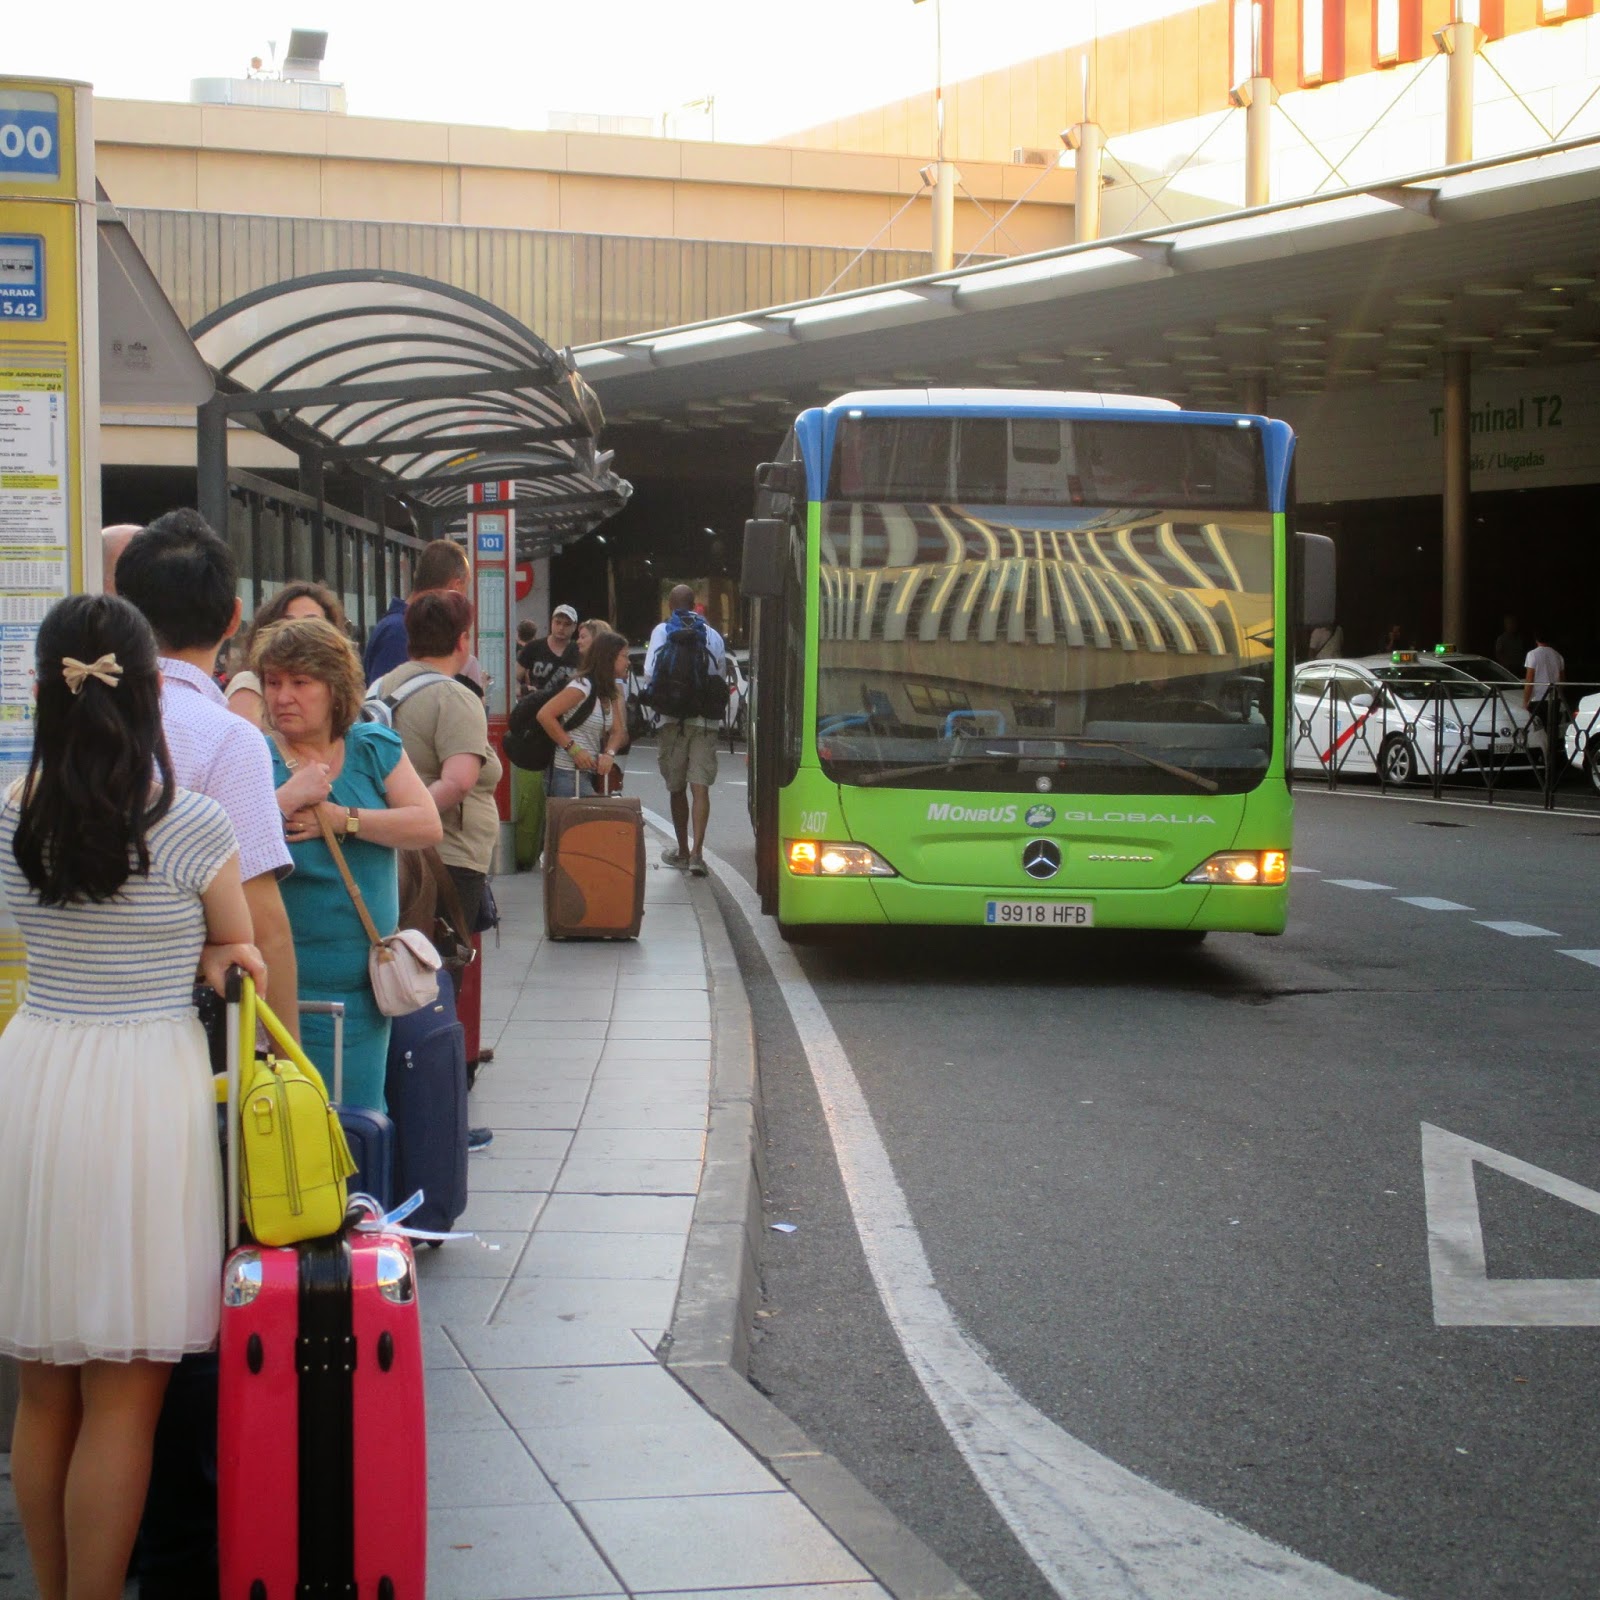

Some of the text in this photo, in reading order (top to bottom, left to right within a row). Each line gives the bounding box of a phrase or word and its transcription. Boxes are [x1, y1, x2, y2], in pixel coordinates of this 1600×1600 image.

[3, 301, 37, 316] 542
[1429, 394, 1563, 437] Tminal T2
[1497, 452, 1545, 472] Llegadas
[481, 537, 499, 549] 101
[800, 811, 828, 834] 2407
[927, 803, 1018, 823] MONBUS
[1064, 810, 1217, 825] GLOBALIA
[1088, 855, 1154, 863] CITARO
[1001, 904, 1087, 924] 9918 HFB
